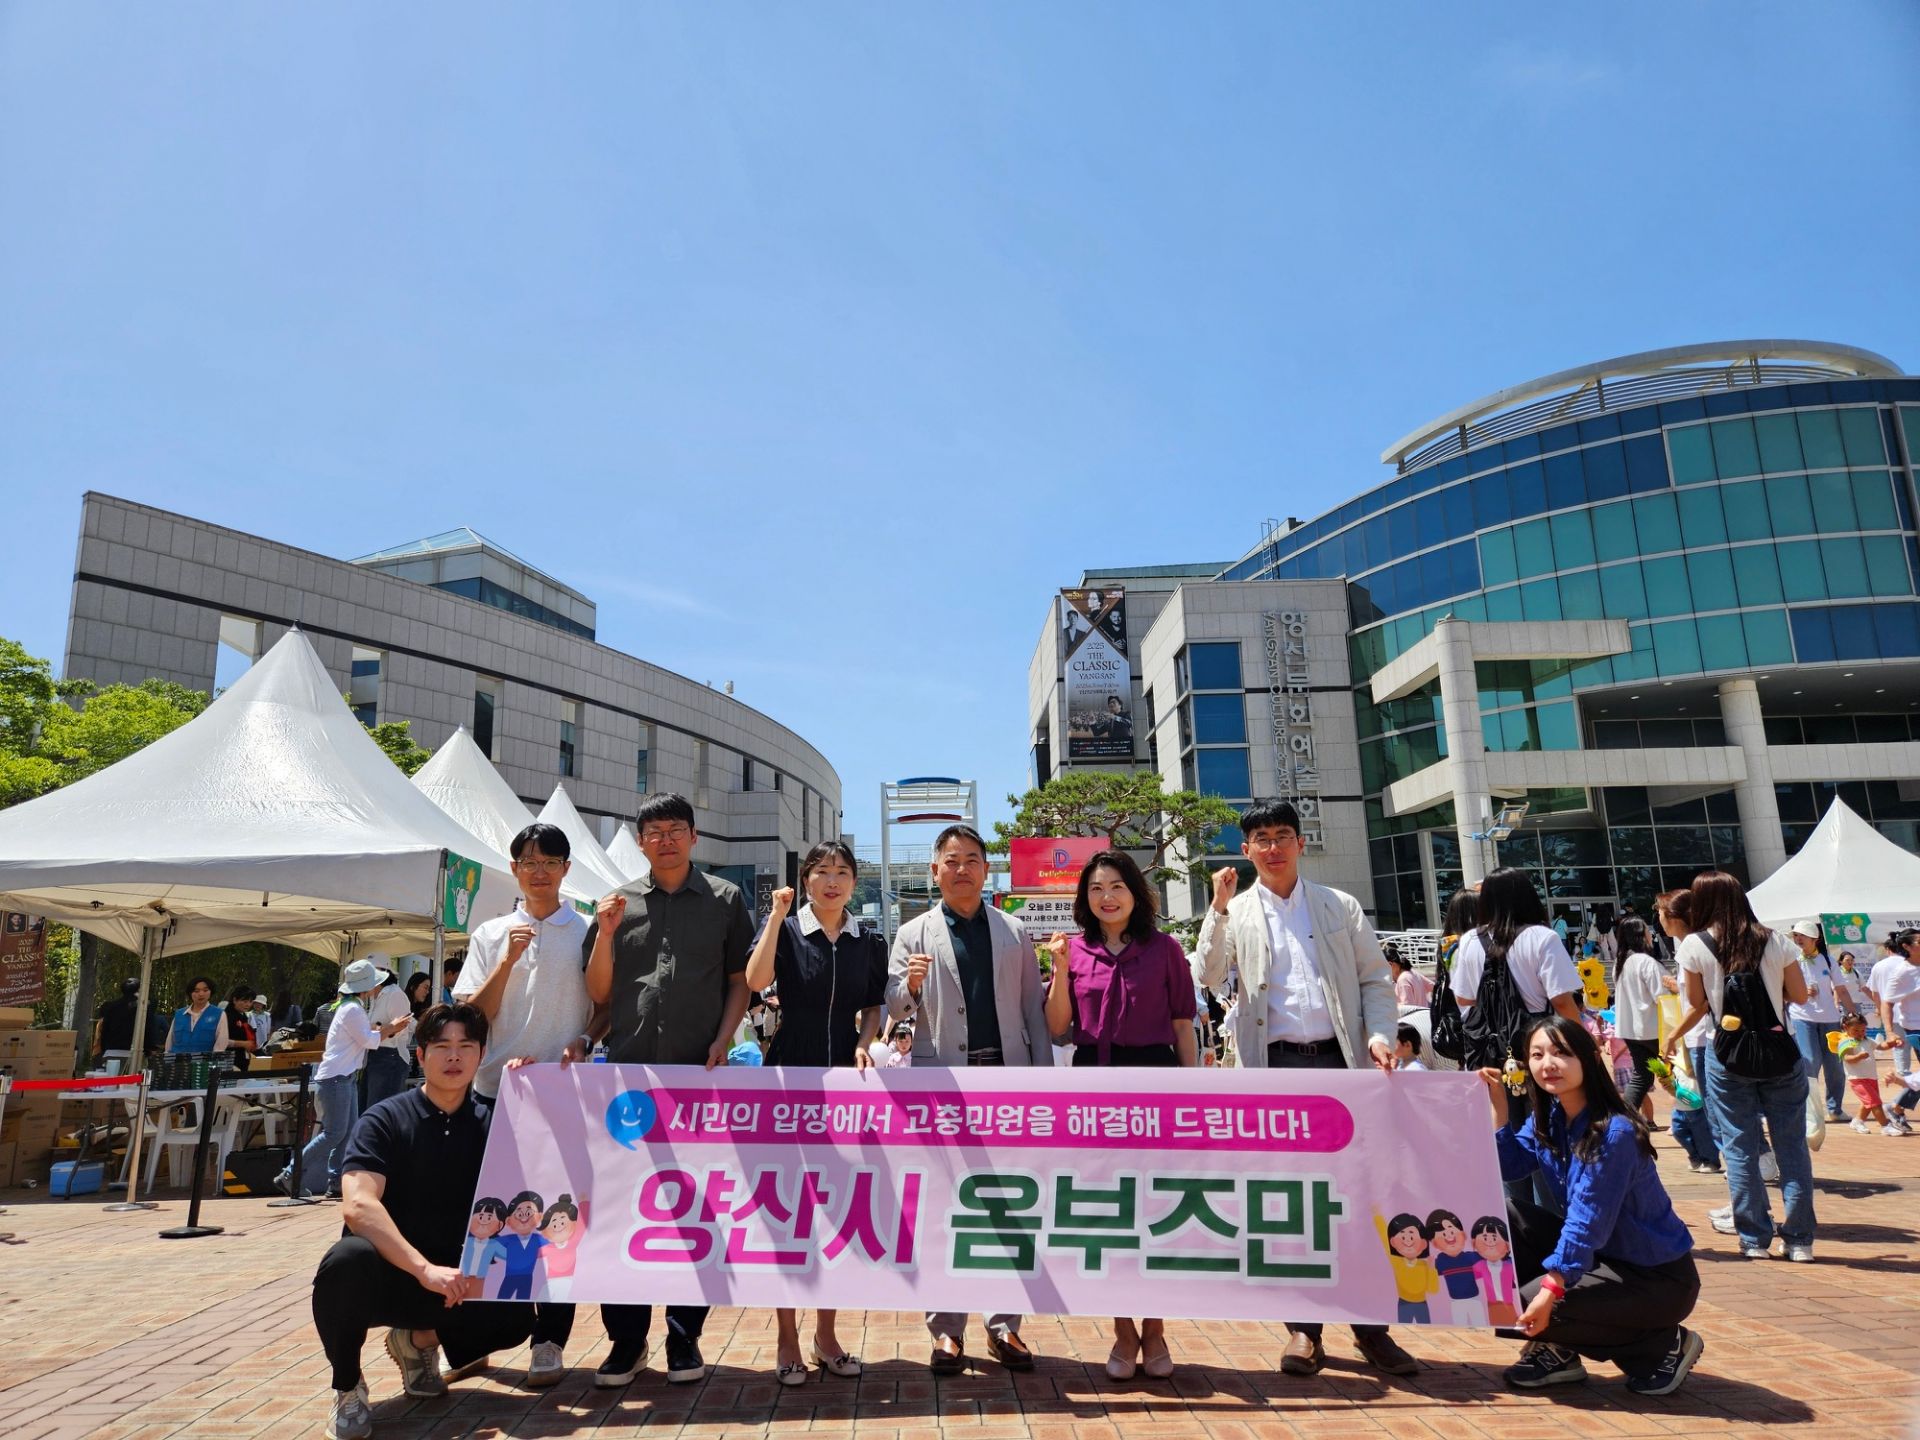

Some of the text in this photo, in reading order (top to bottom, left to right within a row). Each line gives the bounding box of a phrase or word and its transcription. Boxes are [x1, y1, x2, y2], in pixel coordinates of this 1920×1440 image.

[1087, 652, 1104, 660] THE
[1263, 610, 1281, 679] YANGSAN
[1072, 660, 1120, 672] CLASSIC
[1079, 672, 1116, 680] YANGSAN
[1270, 683, 1288, 745] CULTURE
[1280, 609, 1325, 854] 양산문화예술회관
[1028, 902, 1053, 912] 오늘은
[669, 1102, 1312, 1141] 시민의 입장에서 고충민원을 해결해 드립니다!
[626, 1168, 1343, 1279] 양산시 옴부즈만
